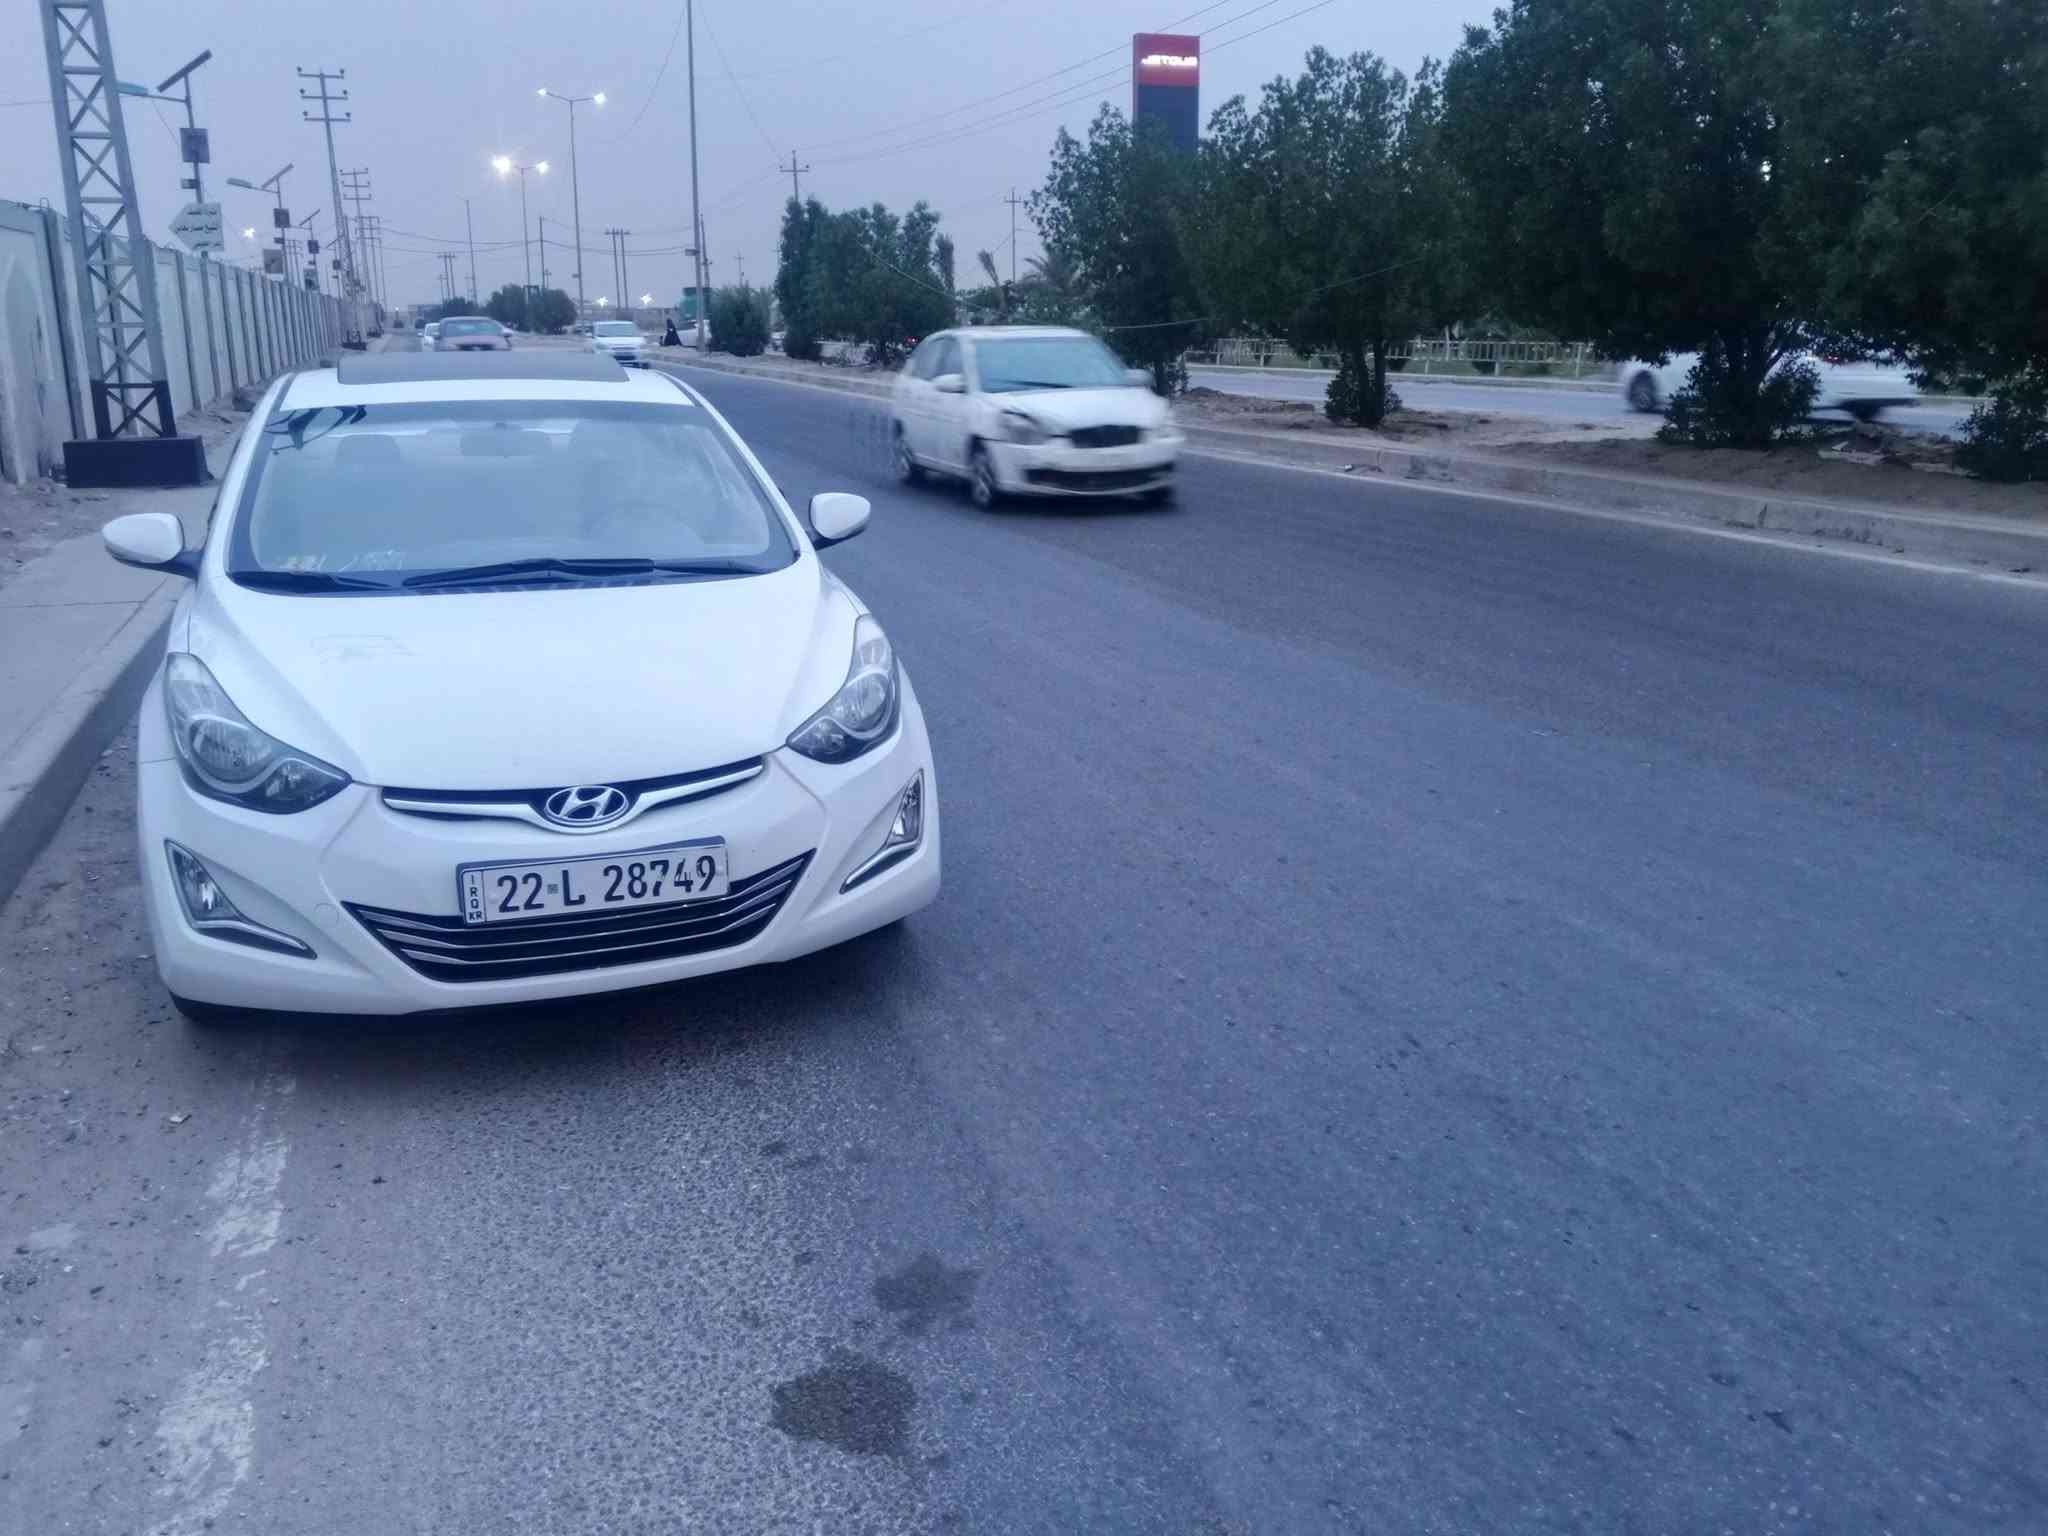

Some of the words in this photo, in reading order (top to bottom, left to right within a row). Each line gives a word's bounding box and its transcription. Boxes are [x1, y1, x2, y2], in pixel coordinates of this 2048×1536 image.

[496, 872, 545, 913] 22
[561, 869, 586, 906] L
[603, 855, 717, 902] 28749
